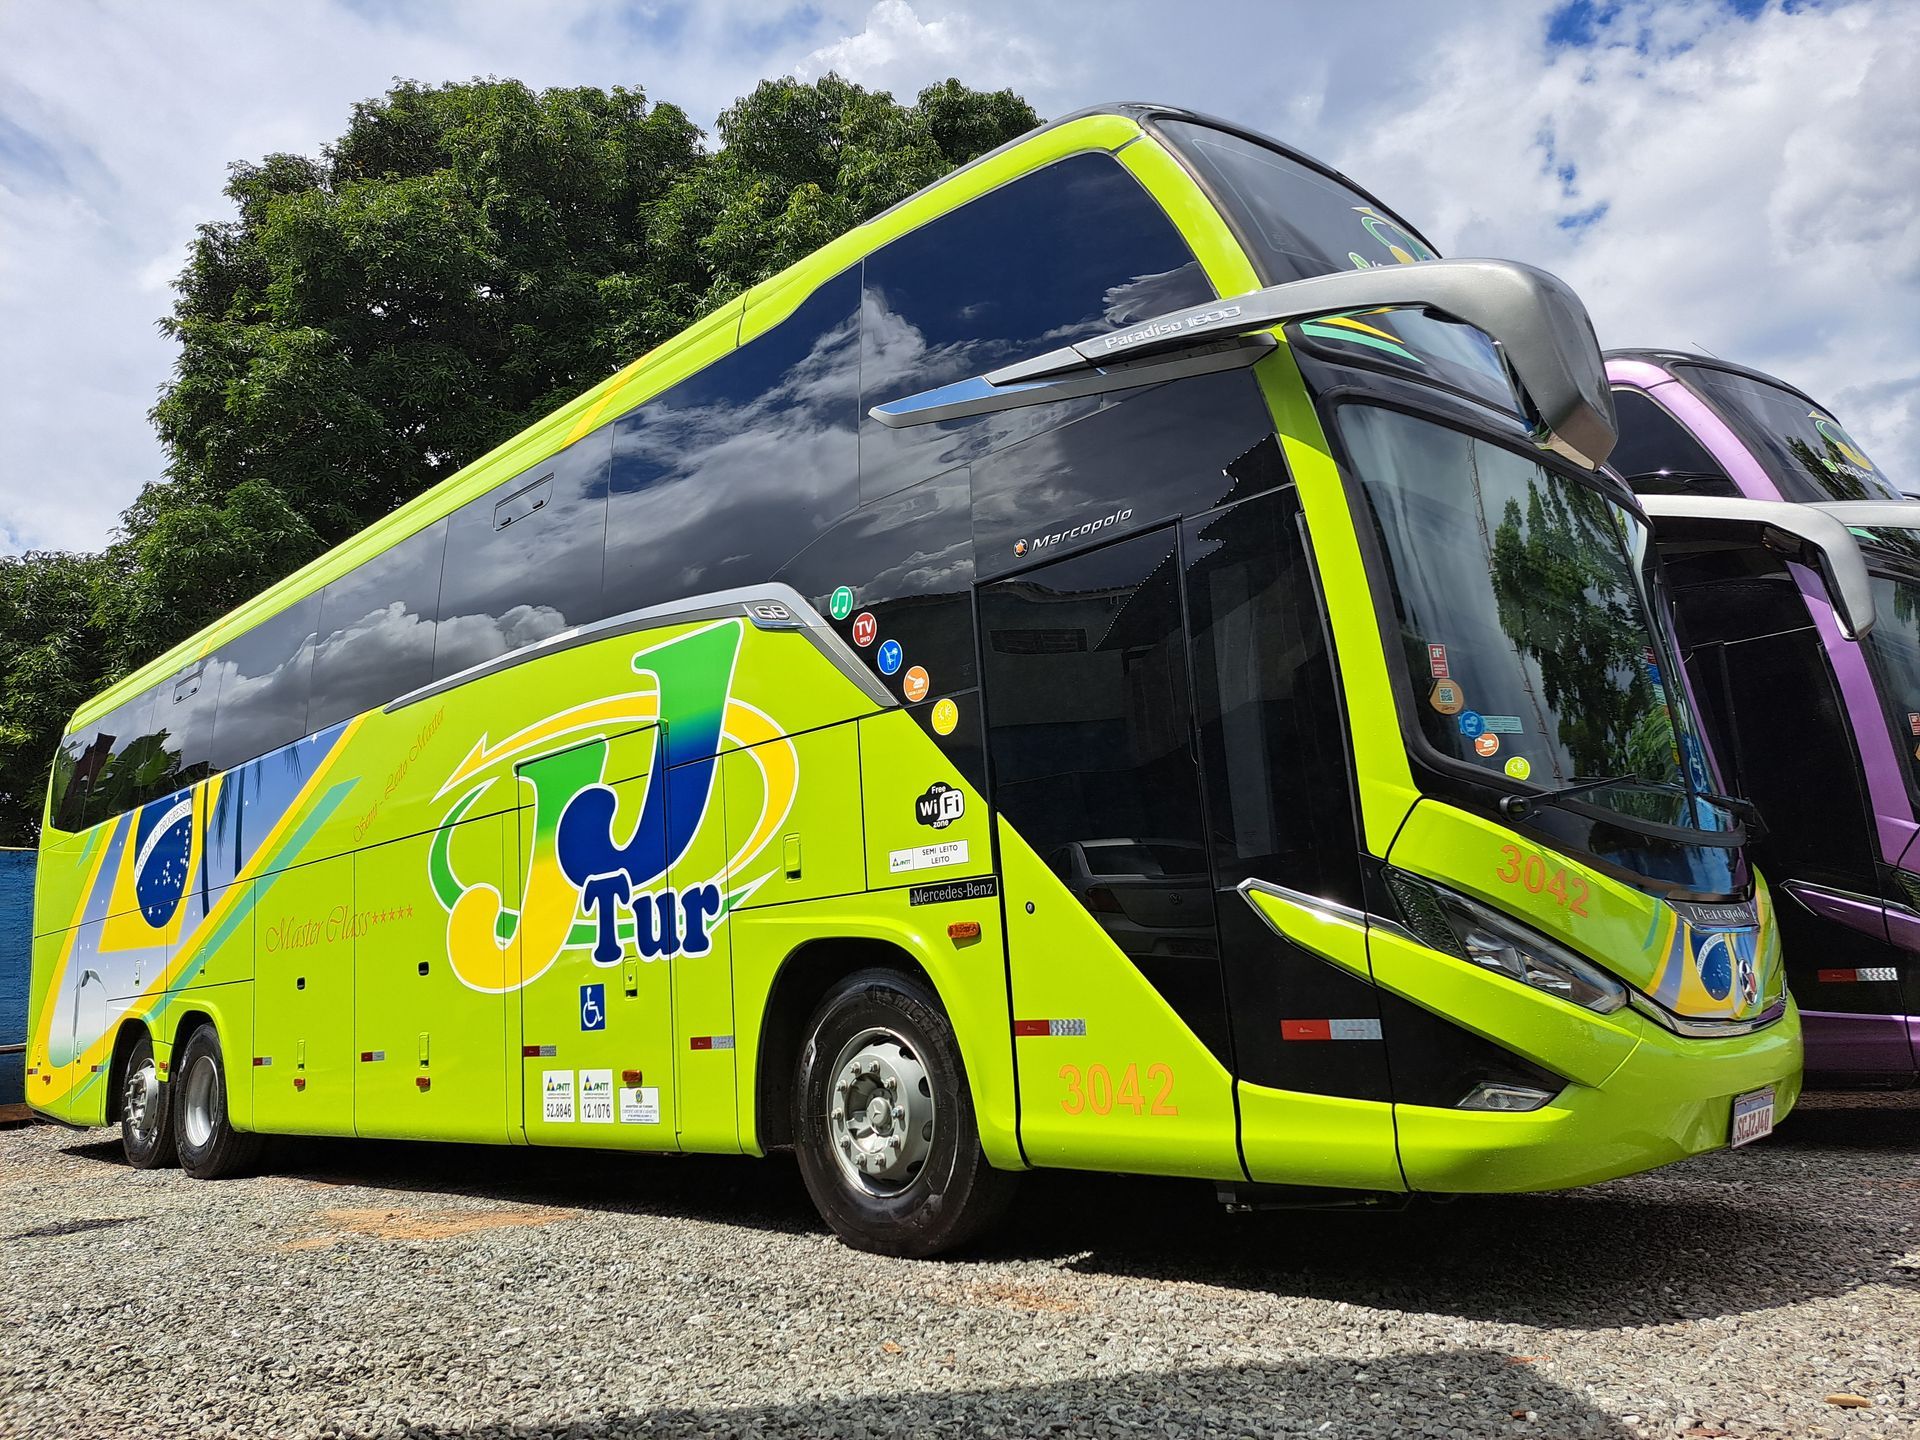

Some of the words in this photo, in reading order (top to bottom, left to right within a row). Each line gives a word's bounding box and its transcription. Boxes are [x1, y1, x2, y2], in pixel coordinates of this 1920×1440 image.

[1104, 321, 1183, 349] Paradiso
[1184, 306, 1241, 328] 1600
[1032, 508, 1133, 551] Marcopolo
[856, 619, 874, 636] TV
[931, 785, 946, 795] Free
[933, 820, 949, 828] zone
[921, 847, 937, 856] SEMI
[939, 844, 959, 853] LEITO
[931, 856, 950, 865] LEITO
[1496, 844, 1589, 918] 3042
[913, 881, 994, 904] Mercedes-Benz
[583, 870, 721, 965] Tur
[265, 915, 324, 953] Master
[326, 904, 371, 943] Class
[555, 1082, 571, 1091] ANTT
[592, 1082, 609, 1091] ANTT
[1059, 1063, 1179, 1116] 3042
[546, 1103, 572, 1118] 52.8846
[583, 1103, 611, 1118] 12.1076
